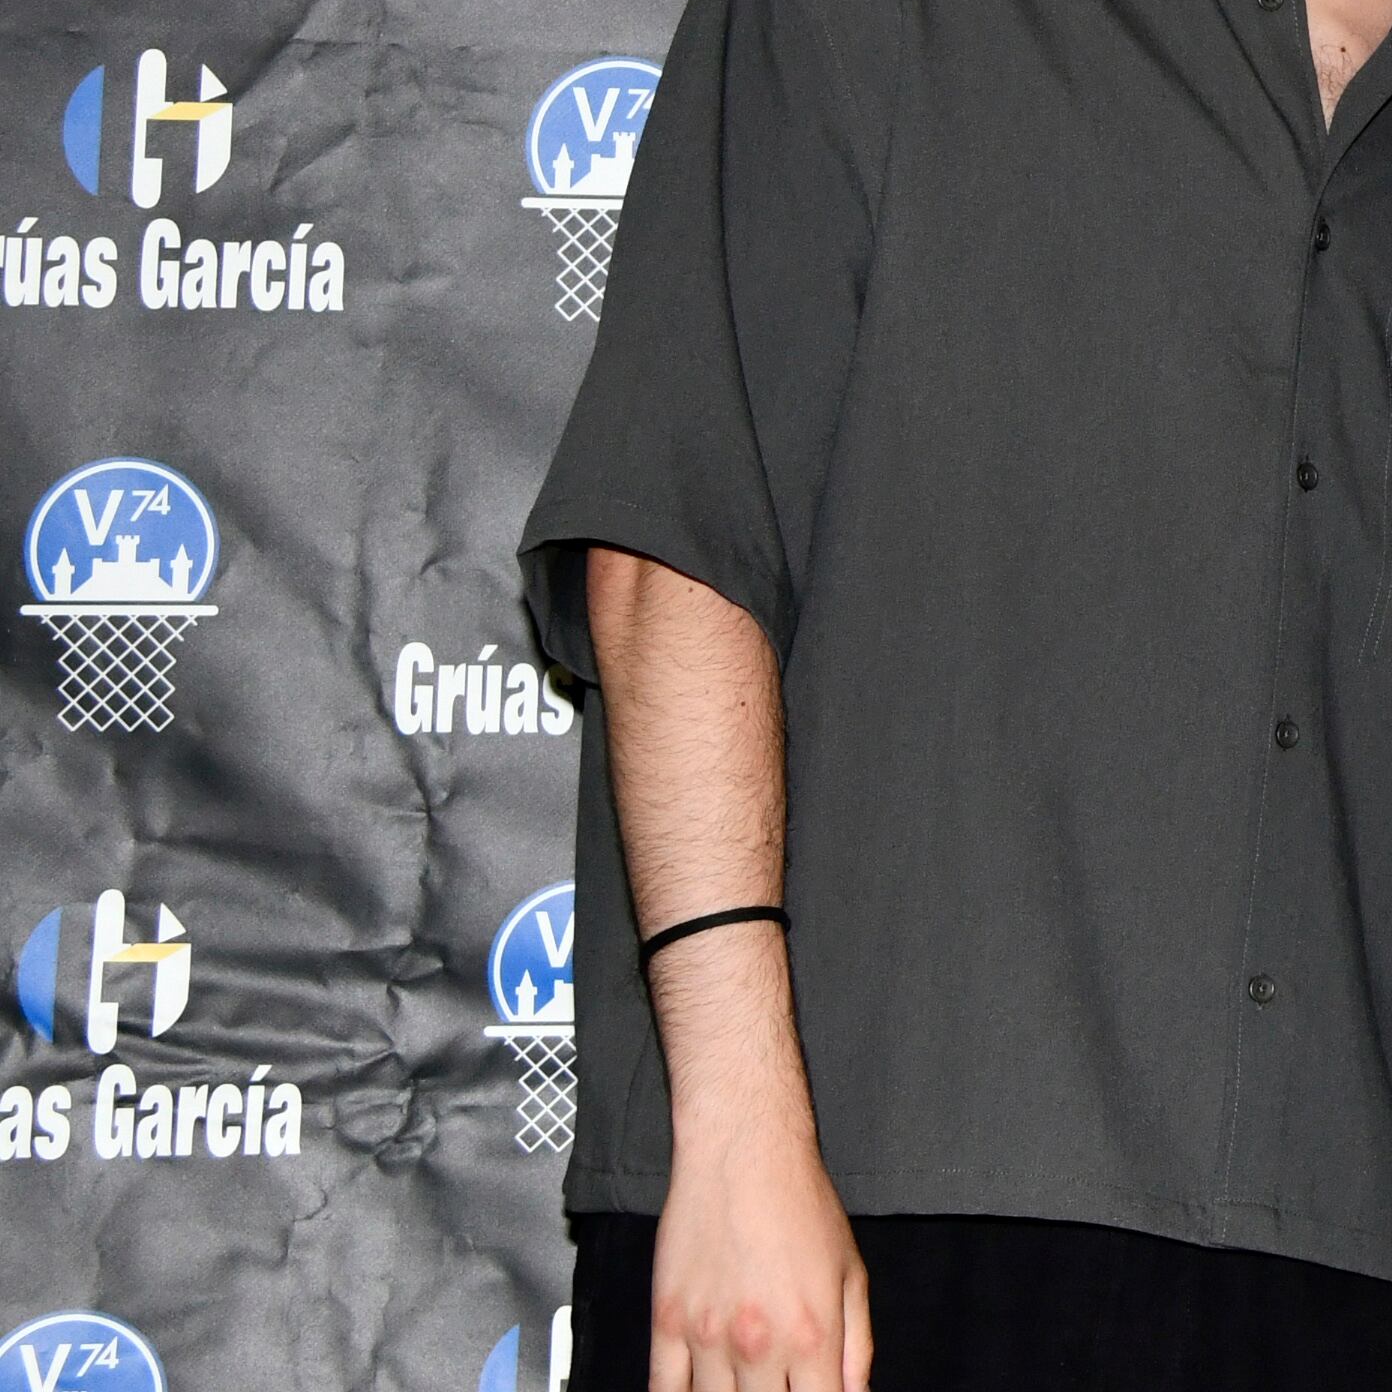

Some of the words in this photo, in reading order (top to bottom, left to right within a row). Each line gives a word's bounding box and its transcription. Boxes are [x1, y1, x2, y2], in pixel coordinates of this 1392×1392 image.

[141, 218, 345, 312] García
[395, 642, 575, 736] Grúas
[94, 1064, 303, 1161] García
